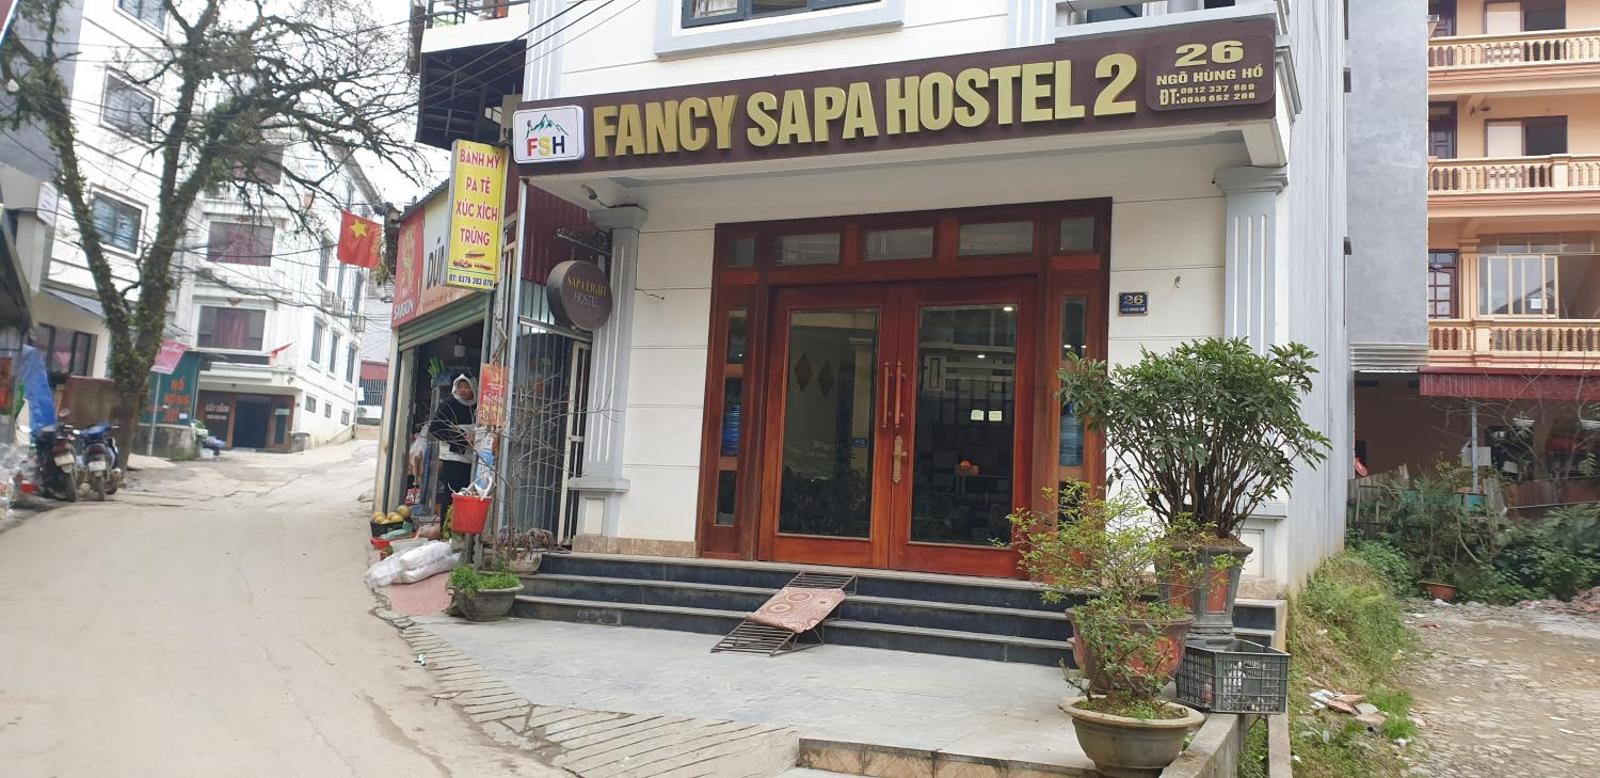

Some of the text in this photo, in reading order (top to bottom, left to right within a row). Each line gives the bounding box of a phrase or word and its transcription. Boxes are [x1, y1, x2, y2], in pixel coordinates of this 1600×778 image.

[1174, 40, 1244, 67] 26
[593, 53, 1138, 158] FANCY SAPA HOSTEL 2
[527, 135, 565, 157] FSH
[466, 177, 478, 192] PA
[456, 198, 498, 222] XÚC XÍCH
[1123, 294, 1144, 305] 26
